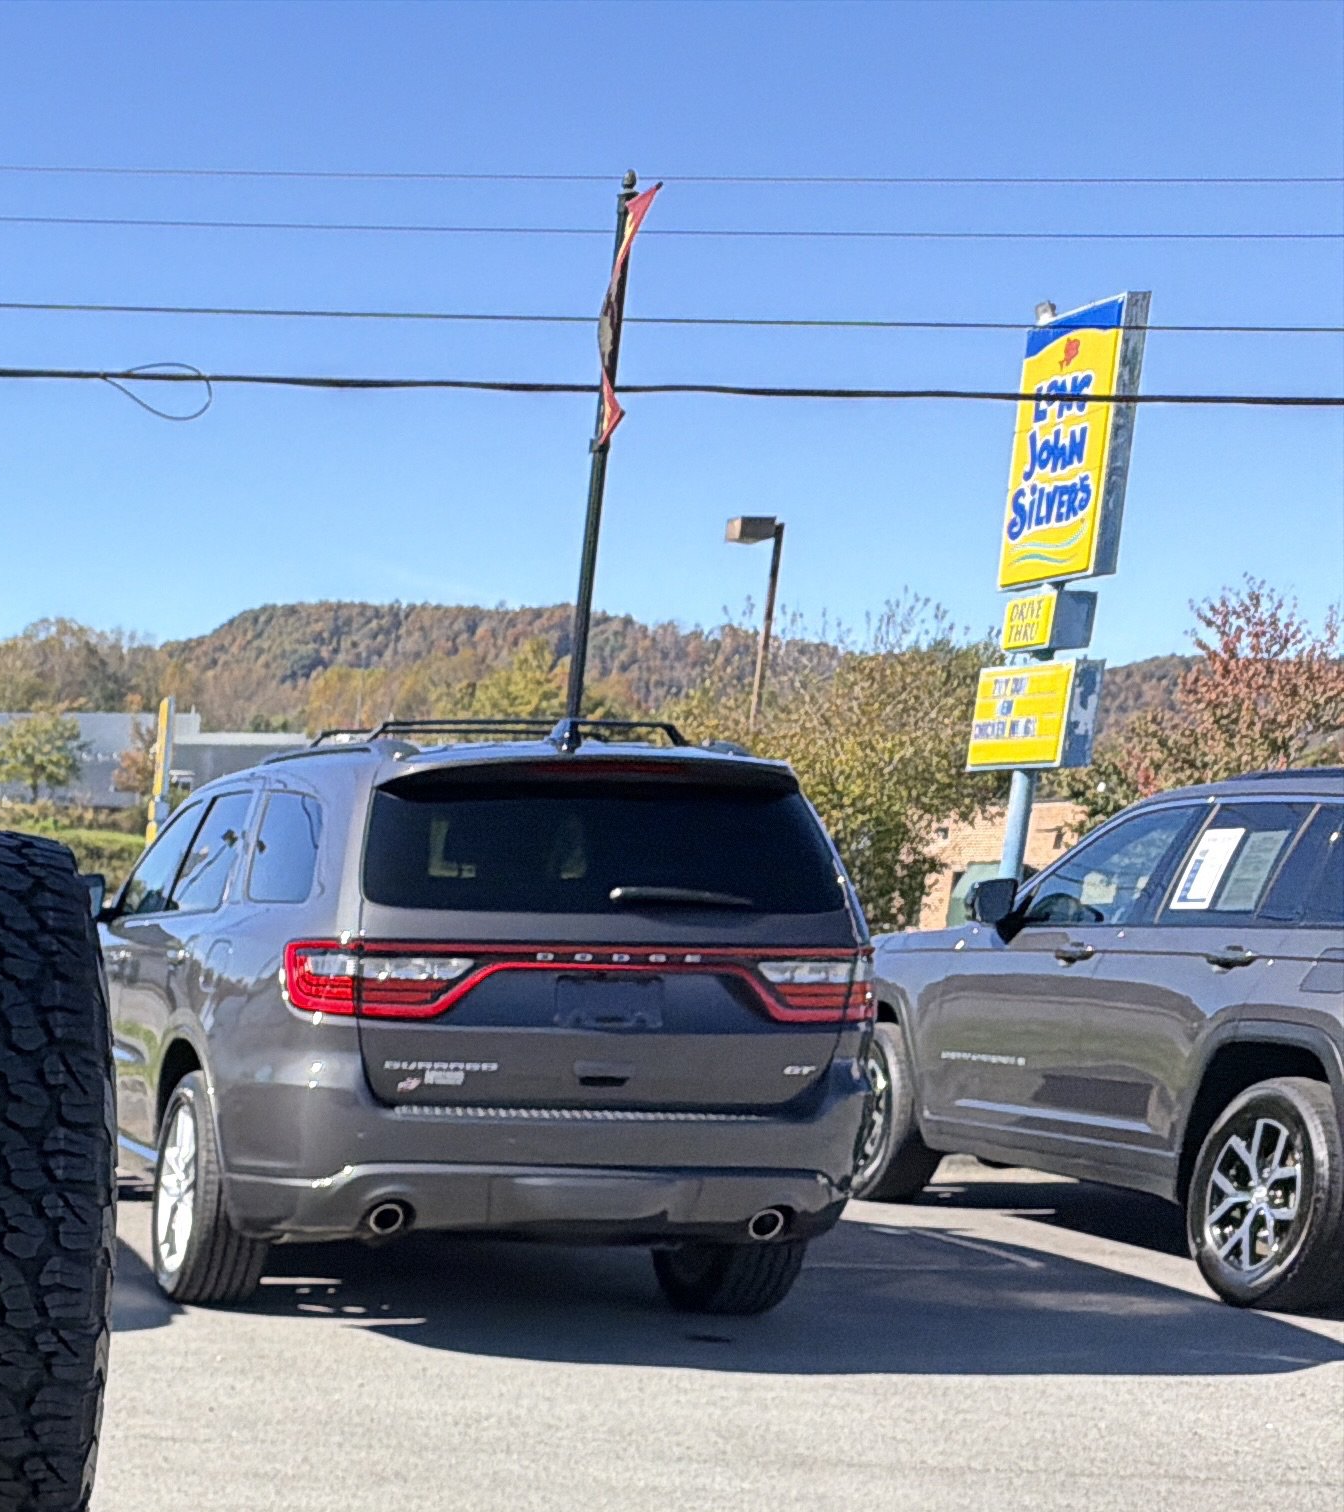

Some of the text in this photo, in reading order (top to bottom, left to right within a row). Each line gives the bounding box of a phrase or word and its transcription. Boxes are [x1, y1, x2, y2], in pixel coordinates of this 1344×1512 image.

[1010, 599, 1043, 623] DRIVE
[1007, 622, 1039, 644] THRU
[536, 952, 702, 963] DODGE
[783, 1065, 816, 1075] GT
